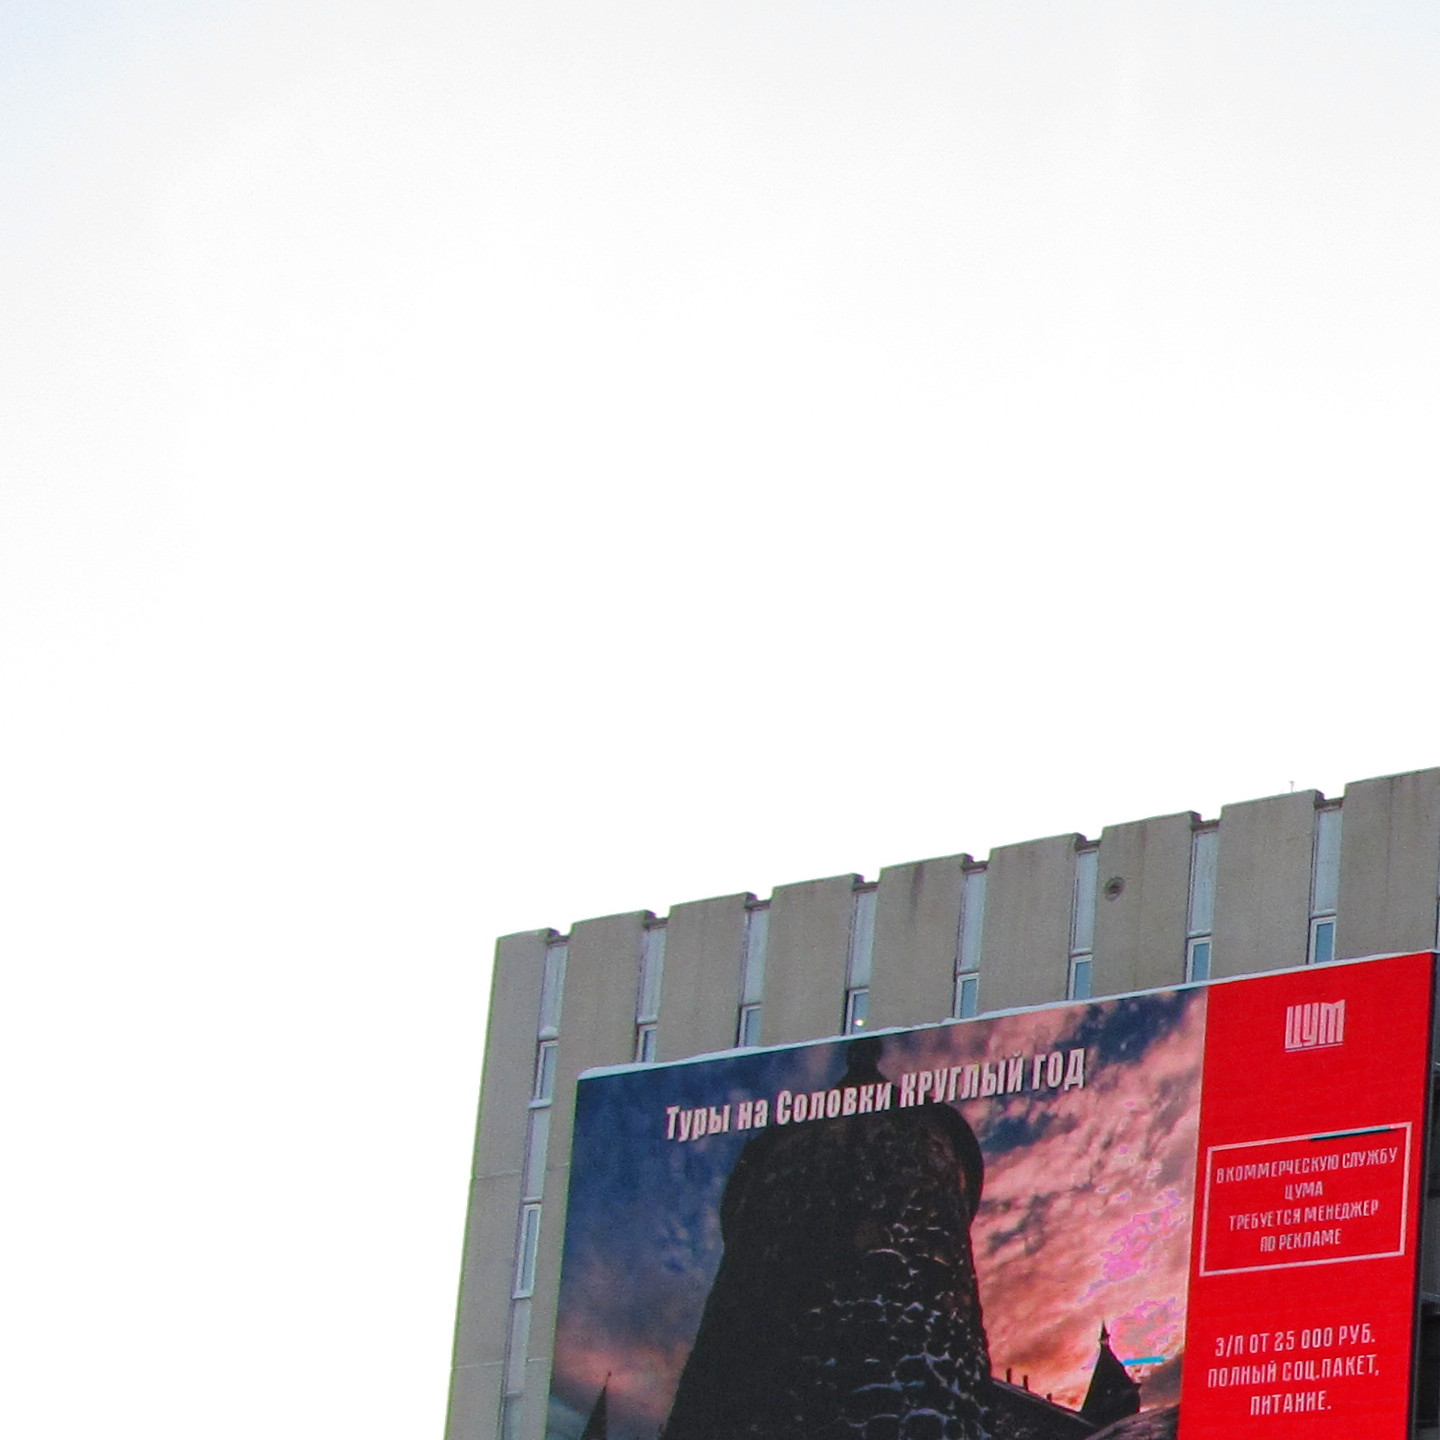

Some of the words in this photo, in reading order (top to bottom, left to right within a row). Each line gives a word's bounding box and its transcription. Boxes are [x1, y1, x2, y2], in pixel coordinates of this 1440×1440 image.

[1284, 1000, 1345, 1050] ЦУМ
[666, 1104, 730, 1142] Туры
[737, 1099, 768, 1131] на
[776, 1081, 892, 1126] Соловки
[900, 1052, 1023, 1108] КРУГЛЫЙ
[1031, 1047, 1085, 1091] ГОД
[1342, 1147, 1398, 1168] СЛУЖБУ
[1285, 1181, 1323, 1201] ЦУМА
[1229, 1208, 1300, 1231] ТРЕБУЕТСЯ
[1304, 1199, 1378, 1224] МЕНЕДЖЕР
[1260, 1236, 1276, 1252] ПО
[1279, 1228, 1342, 1250] РЕКЛАМЕ
[1249, 1332, 1269, 1353] ОТ
[1274, 1331, 1295, 1351] 25
[1301, 1327, 1333, 1348] 000
[1338, 1323, 1376, 1345] РУБ.
[1208, 1360, 1276, 1388] ПОЛНЫЙ
[1251, 1390, 1332, 1415] ПИТАНИЕ.
